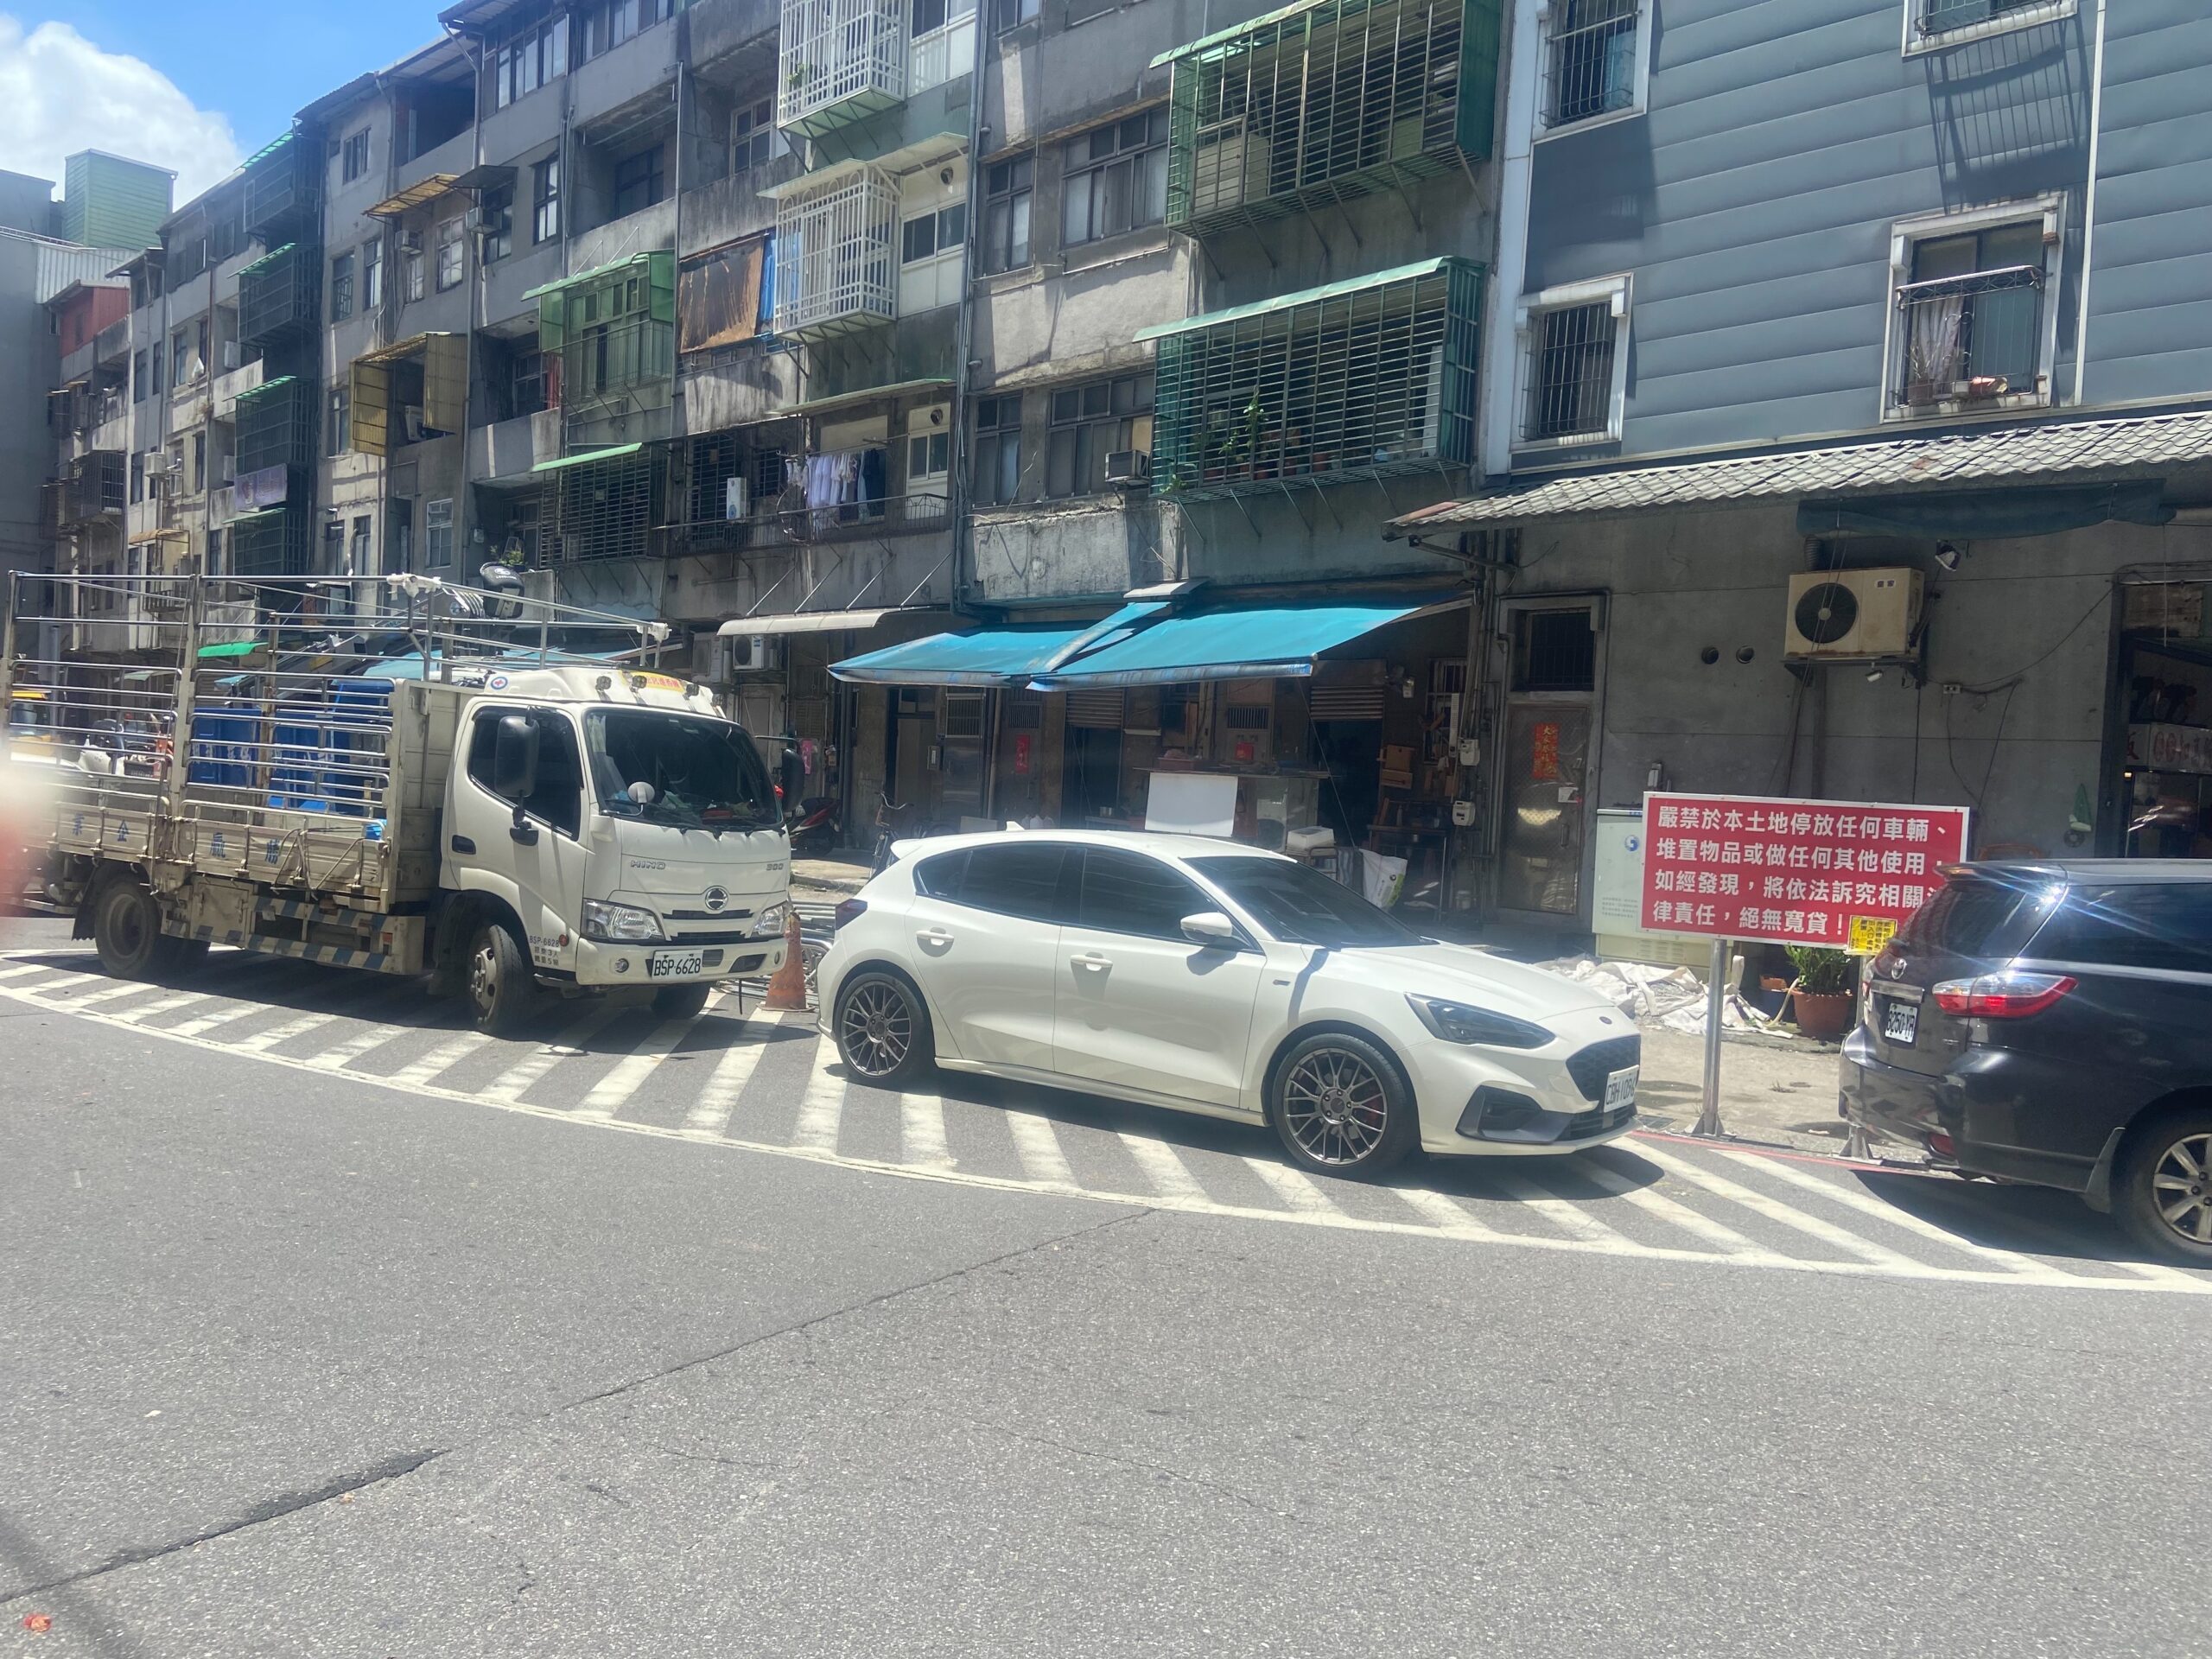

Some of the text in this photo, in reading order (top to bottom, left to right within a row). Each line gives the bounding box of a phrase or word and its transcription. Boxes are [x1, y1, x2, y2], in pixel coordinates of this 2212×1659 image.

[1657, 805, 1946, 842] 嚴禁於本土地停放任何車輛、
[630, 860, 666, 870] HINO
[1652, 900, 1842, 936] 律責任，絕無寬貸！
[529, 936, 560, 948] BSP-6628
[653, 957, 702, 976] BSP-6628
